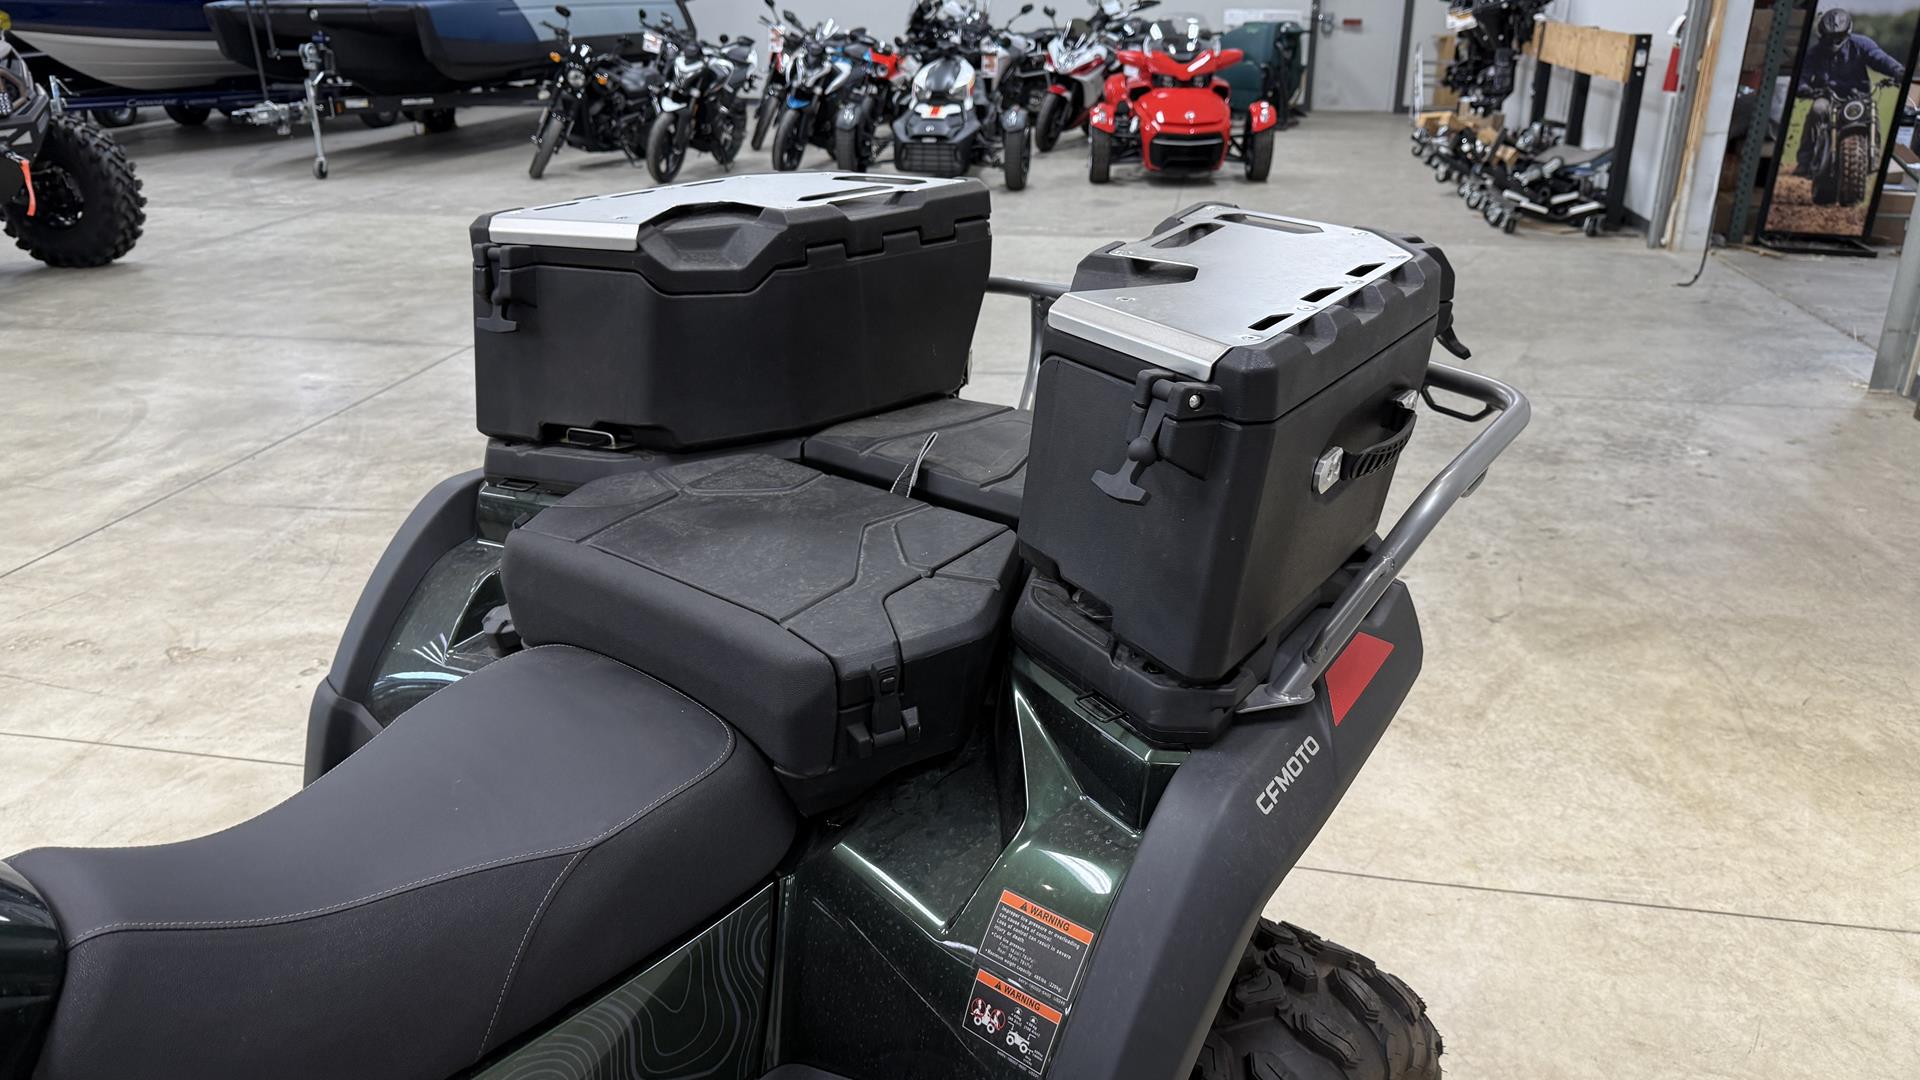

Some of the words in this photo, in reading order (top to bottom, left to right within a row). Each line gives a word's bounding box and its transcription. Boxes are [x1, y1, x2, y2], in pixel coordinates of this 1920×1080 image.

[1256, 736, 1320, 815] CFMOTO
[995, 918, 1007, 927] Loss
[1007, 916, 1020, 926] cause
[1020, 922, 1030, 931] loss
[1029, 905, 1070, 932] WARNING
[1003, 984, 1041, 1011] WARNING
